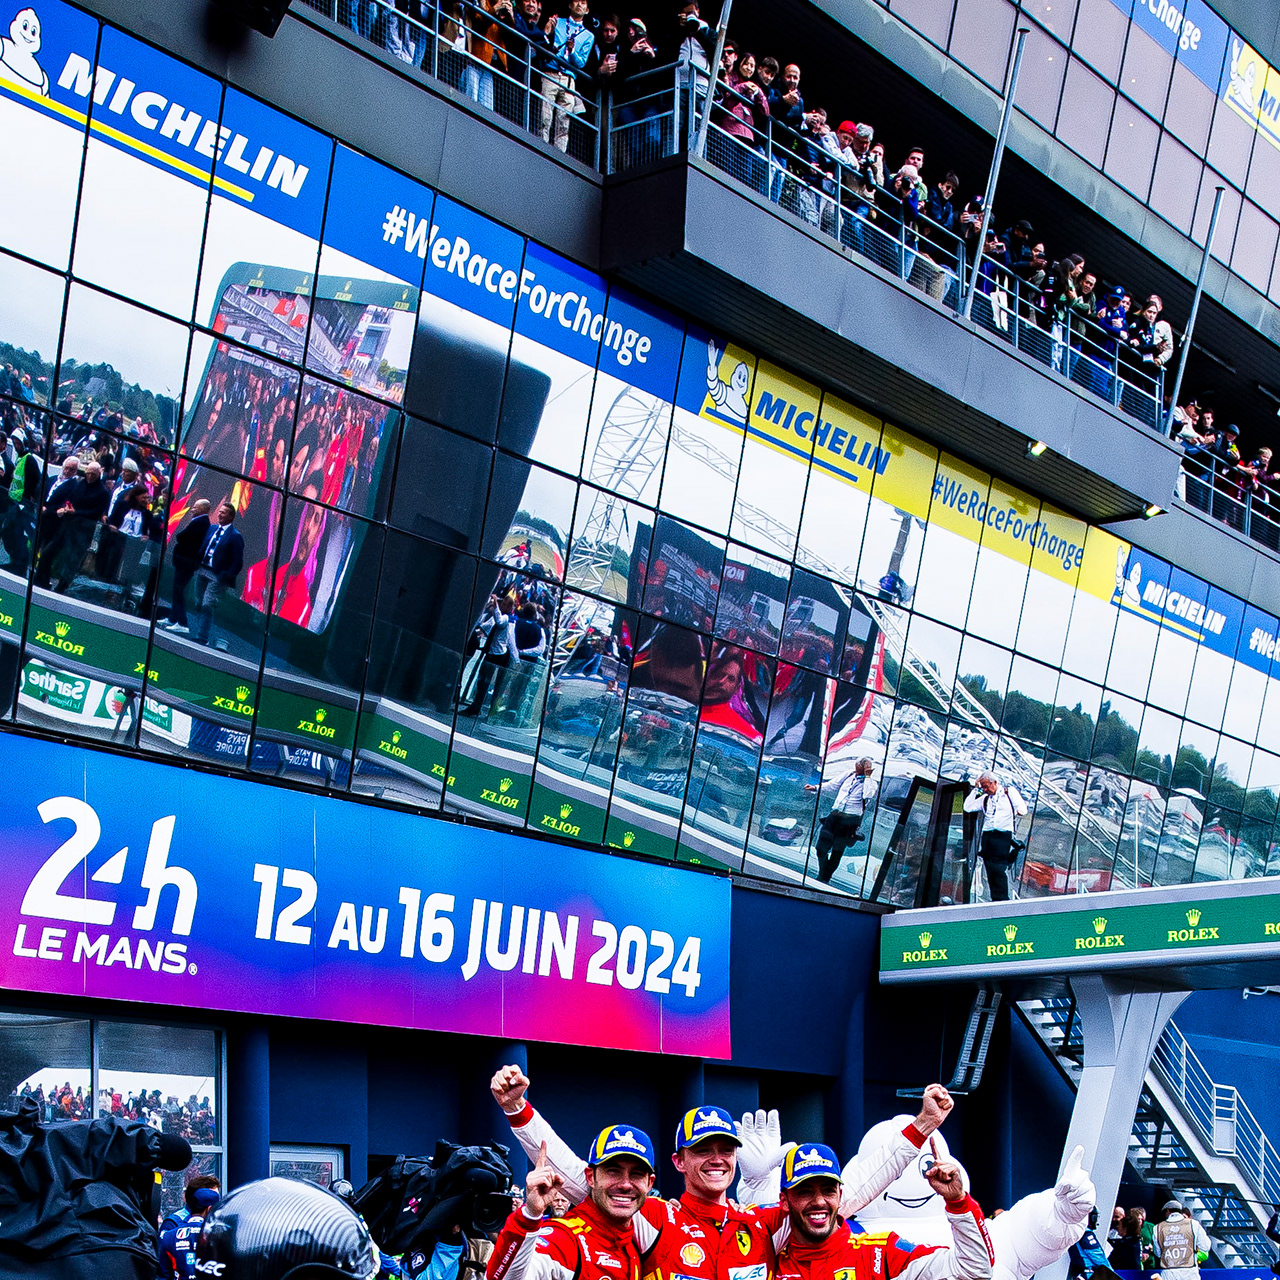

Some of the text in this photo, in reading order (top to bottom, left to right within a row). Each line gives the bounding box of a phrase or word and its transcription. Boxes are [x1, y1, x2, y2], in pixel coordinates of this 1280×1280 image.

[57, 52, 310, 199] MICHELIN
[381, 204, 652, 366] #WeRaceForChange
[754, 391, 891, 475] MICHELIN
[931, 473, 1084, 571] #WeRaceForChange
[1142, 581, 1227, 635] MICHELIN
[20, 796, 198, 936] 24h
[13, 924, 189, 975] LE MANS
[252, 862, 702, 998] 12 AU 16 JUIN 2024
[902, 948, 947, 963] ROLEX
[987, 942, 1034, 957] ROLEX
[1075, 934, 1125, 950] ROLEX
[1167, 927, 1220, 943] ROLEX
[1164, 1246, 1187, 1260] A07
